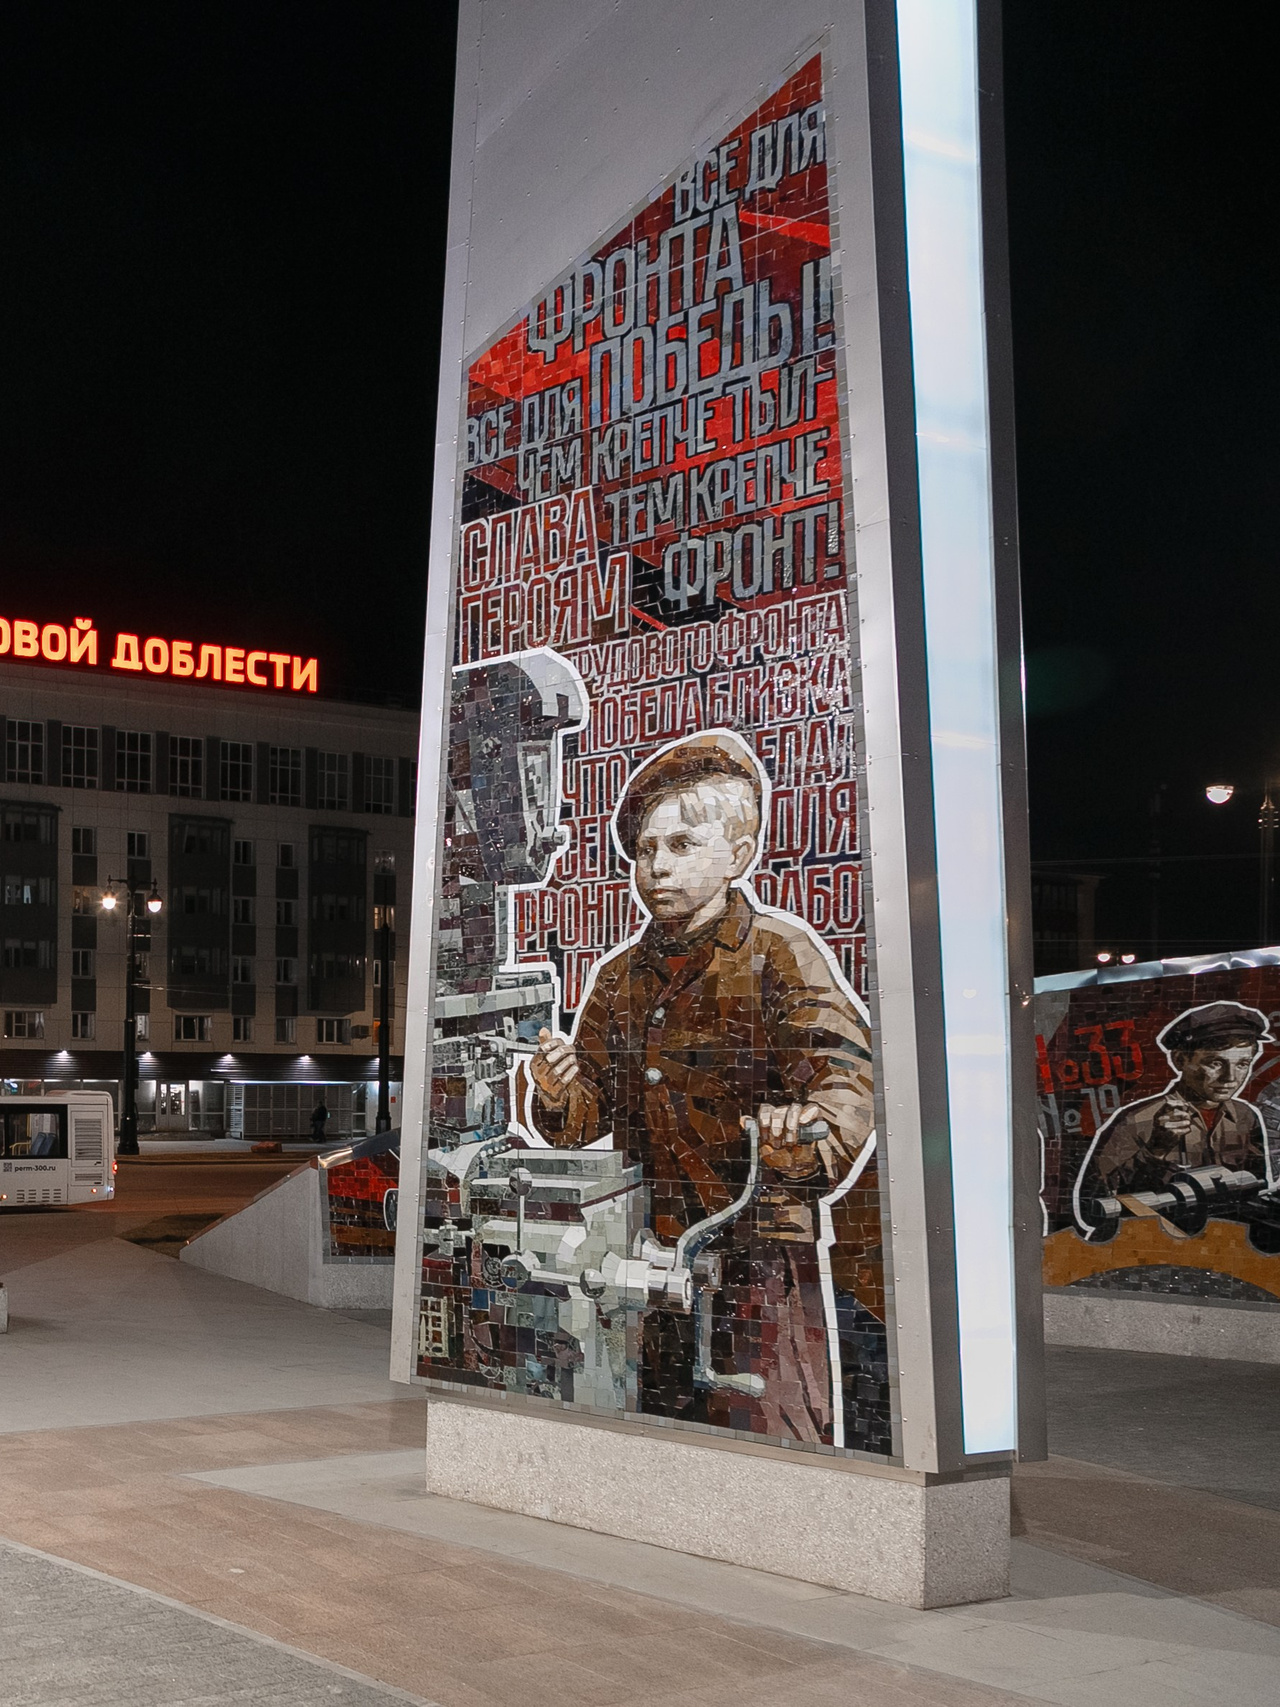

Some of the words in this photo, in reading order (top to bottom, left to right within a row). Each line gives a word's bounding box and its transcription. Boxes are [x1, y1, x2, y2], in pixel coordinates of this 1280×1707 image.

[674, 139, 742, 224] ВСЕ
[745, 102, 826, 202] ДЛЯ
[526, 202, 745, 364] ФРОНТА
[466, 402, 514, 464] ВСЕ
[520, 377, 584, 446] ДЛЯ
[517, 435, 582, 502] ЧЕМ
[591, 397, 717, 485] КРЕПЧЕ
[460, 486, 598, 592] СЛАВА
[604, 471, 685, 547] ТЕМ
[689, 426, 832, 527] КРЕПЧЕ
[457, 551, 631, 665] ГЕРОЯМ
[662, 501, 840, 611] ФРОНТ!
[112, 633, 318, 692] ДОБЛЕСТИ
[715, 589, 851, 666] ФРОНТА
[578, 677, 706, 756] ПОБЕДА
[705, 650, 853, 729] БЛИЗКА
[562, 751, 630, 819] ЧТО
[759, 778, 862, 870] ДЛЯ
[14, 1164, 56, 1172] perm-300.ru
